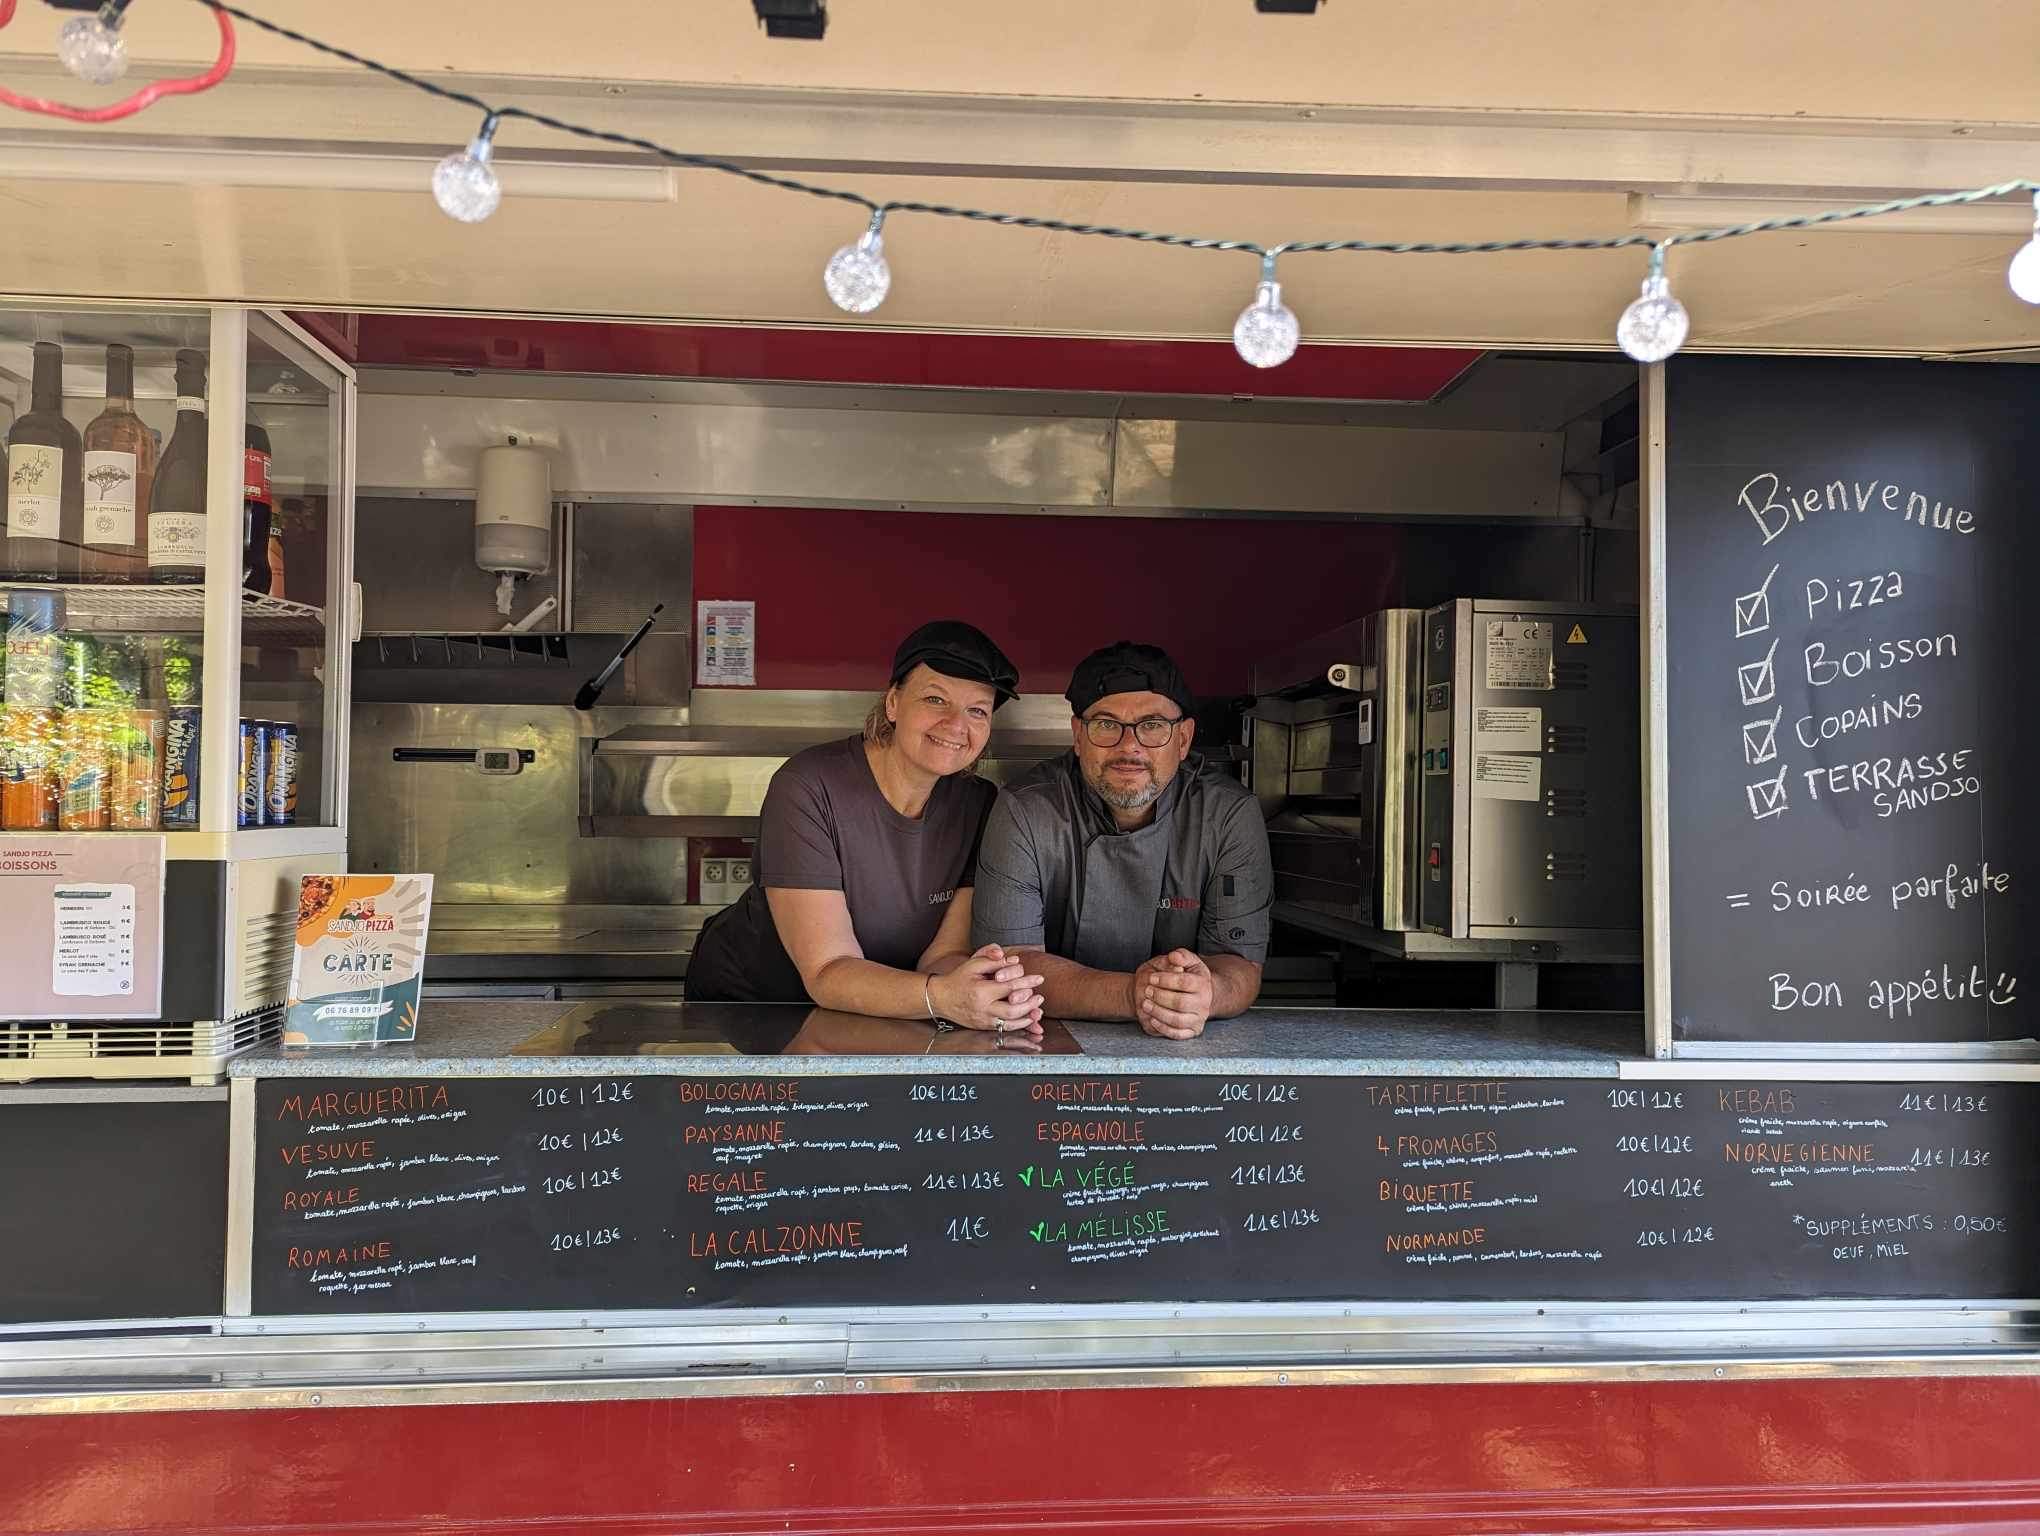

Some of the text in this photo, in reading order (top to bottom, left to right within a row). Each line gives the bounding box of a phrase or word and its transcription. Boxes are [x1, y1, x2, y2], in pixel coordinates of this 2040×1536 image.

[1737, 472, 1976, 546] Bienvenue
[1806, 571, 1903, 620] Pizza
[1805, 633, 1957, 686] Boisson
[1796, 693, 1922, 748] COPAINS
[1803, 750, 1974, 800] TERRASSE
[1873, 776, 1981, 817] SANDJO
[1769, 873, 1872, 912] Soirée
[1891, 862, 2010, 910] parfaite
[365, 919, 394, 932] PIZZA
[323, 953, 393, 972] CARTE
[1769, 963, 1985, 1019] Bon appétit
[278, 1085, 449, 1120] MARGUERITA
[681, 1080, 800, 1103] BOLOGNAISE
[1031, 1081, 1141, 1102] ORIENTALE
[1366, 1081, 1511, 1105] TARTIFLETTE
[1719, 1088, 1795, 1113] KEBAB
[685, 1120, 786, 1145] PAYSANNE
[1038, 1120, 1145, 1142] ESPAGNOLE
[1376, 1130, 1497, 1157] 4 FROMAGES
[281, 1140, 375, 1165] VESUVE
[1725, 1141, 1875, 1163] NORVEGIENNE
[687, 1171, 768, 1193] REGALE
[1040, 1160, 1135, 1188] LA VÉGÉ
[284, 1187, 360, 1210] ROYALE
[1380, 1178, 1474, 1203] BIQUETTE
[946, 1216, 989, 1242] 11€
[1045, 1210, 1170, 1243] LA MÉLISSE
[1954, 1214, 2008, 1236] 0,50€
[691, 1222, 863, 1257] LA CALZONNE
[1386, 1228, 1486, 1252] NORMANDE
[1876, 1242, 1910, 1257] MIEL
[288, 1241, 392, 1268] ROMAINE
